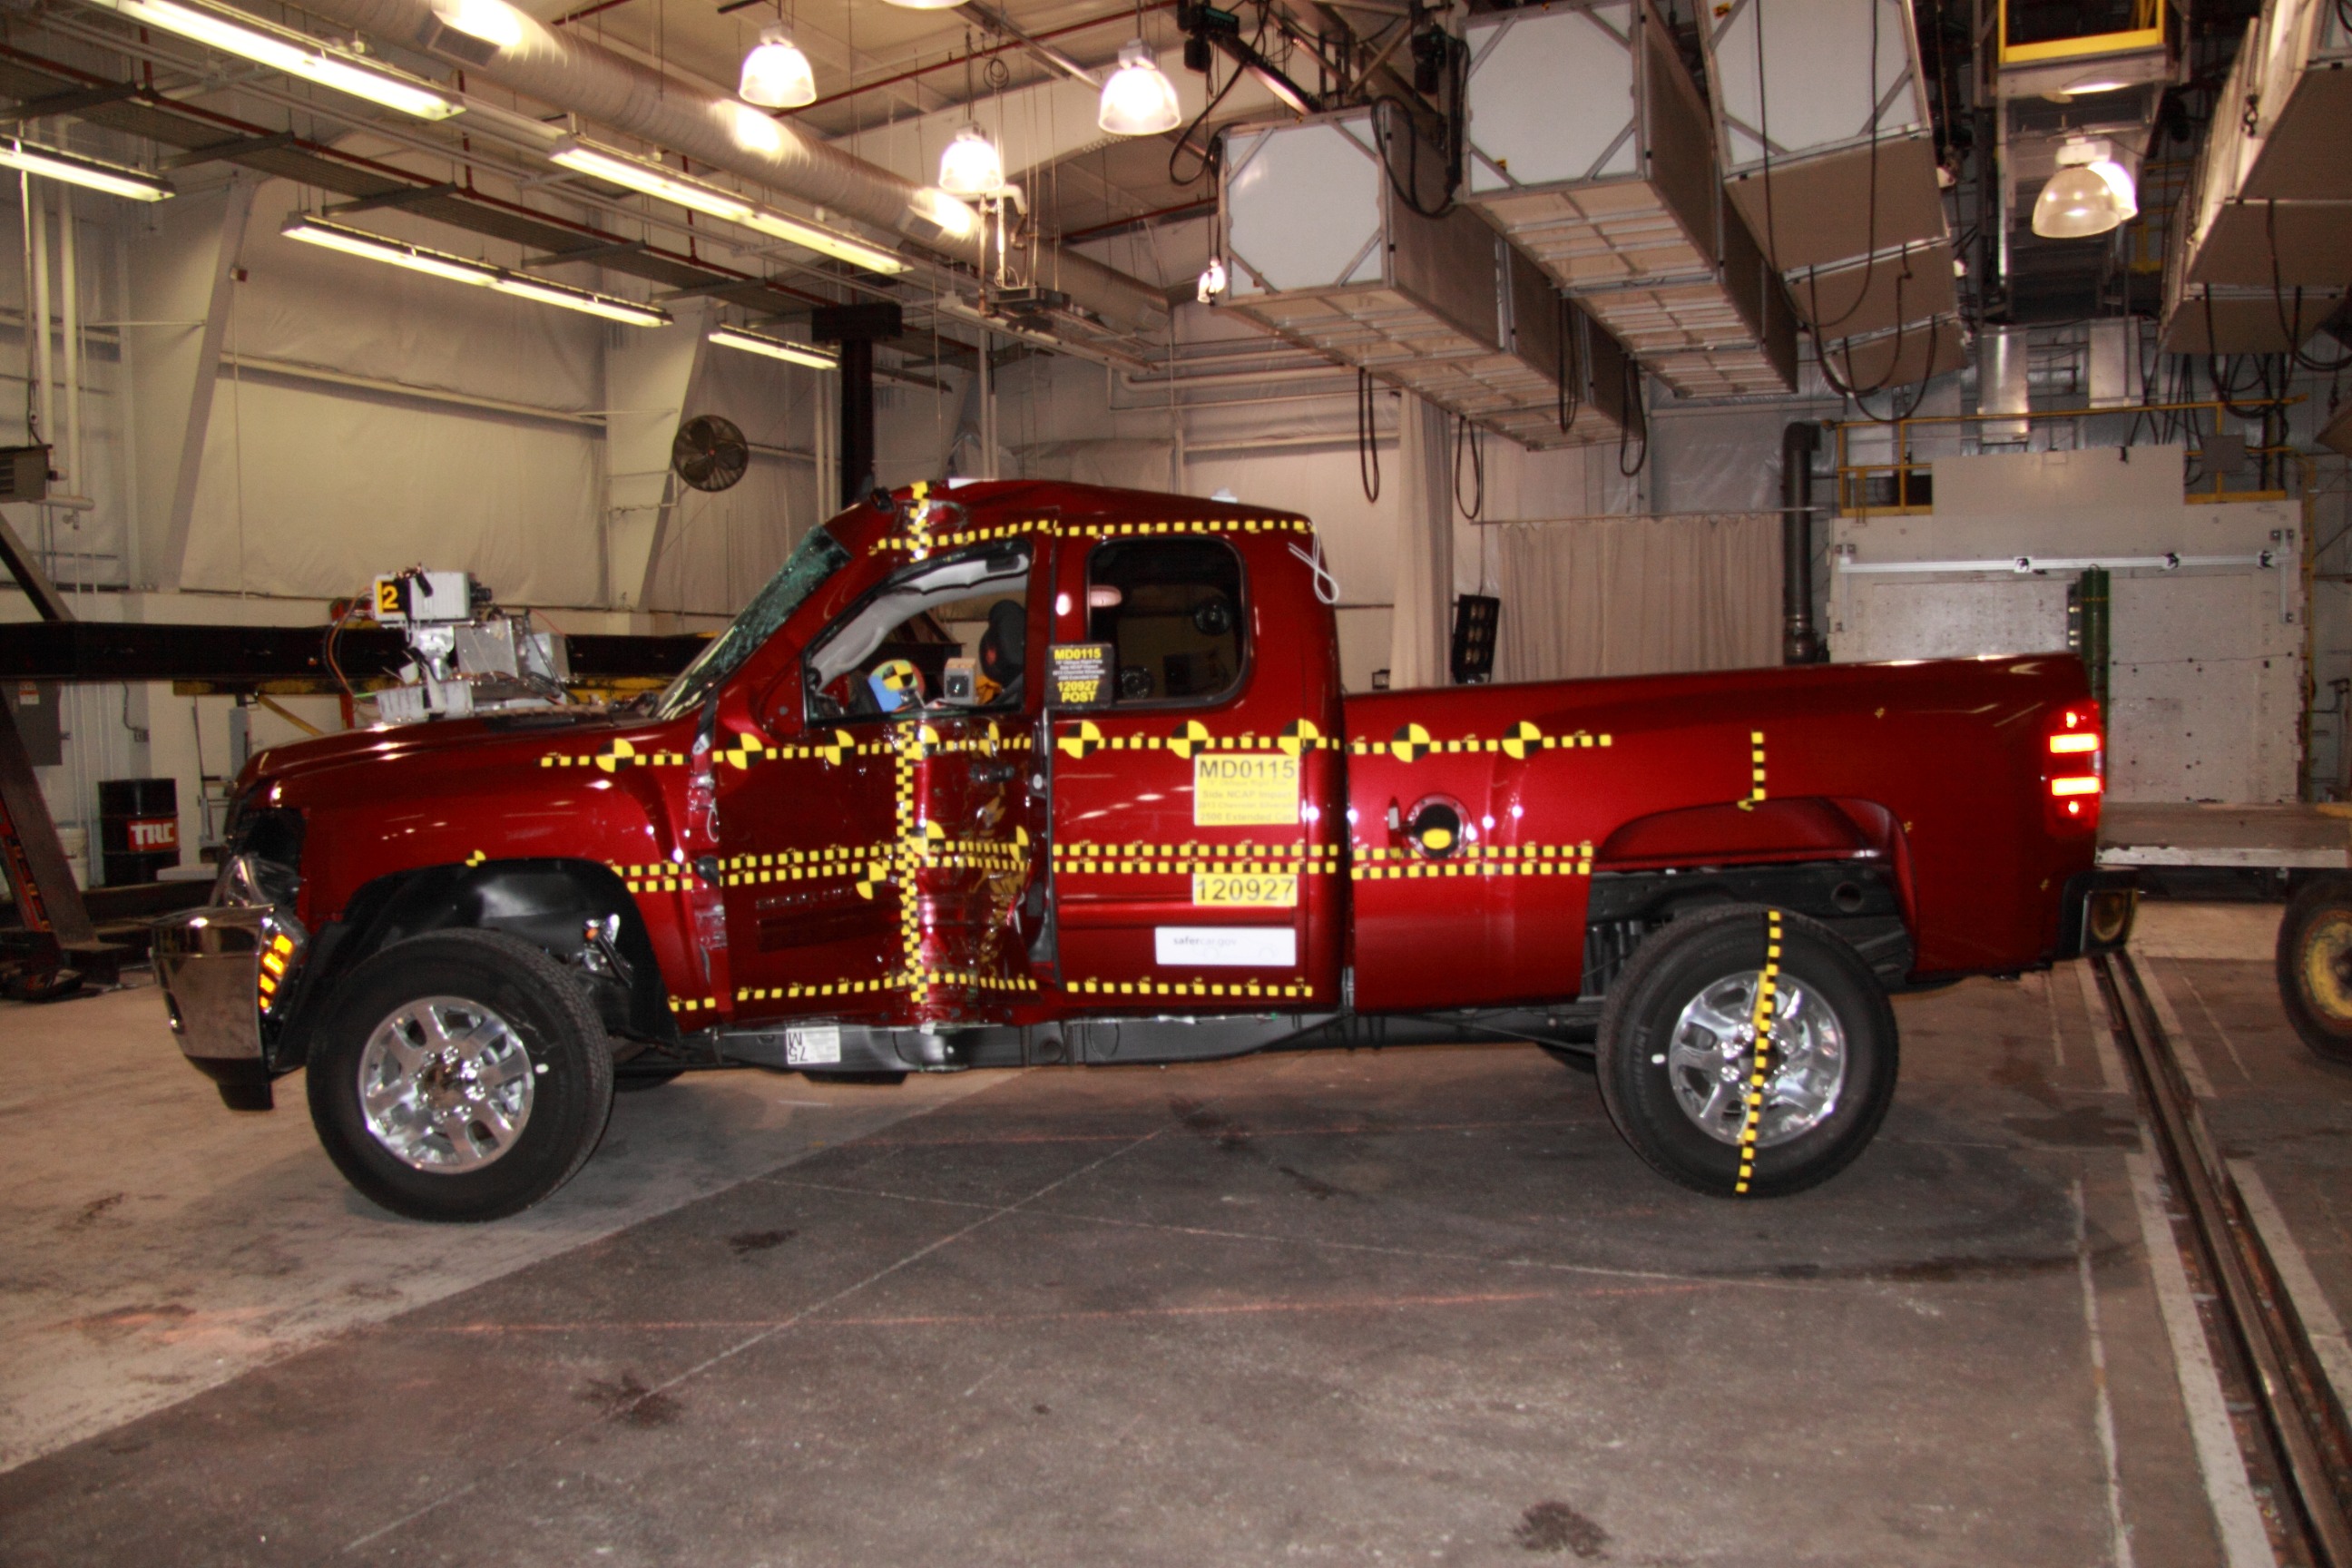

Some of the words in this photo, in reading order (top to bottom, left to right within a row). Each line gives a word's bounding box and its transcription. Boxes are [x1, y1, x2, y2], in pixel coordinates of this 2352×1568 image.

[382, 585, 398, 609] 2
[1054, 647, 1102, 661] MD0115
[1056, 680, 1100, 692] 120927
[1061, 691, 1096, 703] POST
[1199, 759, 1296, 779] MD0115
[1227, 790, 1255, 799] NCAP
[130, 822, 175, 845] TRC
[1195, 878, 1296, 901] 120927
